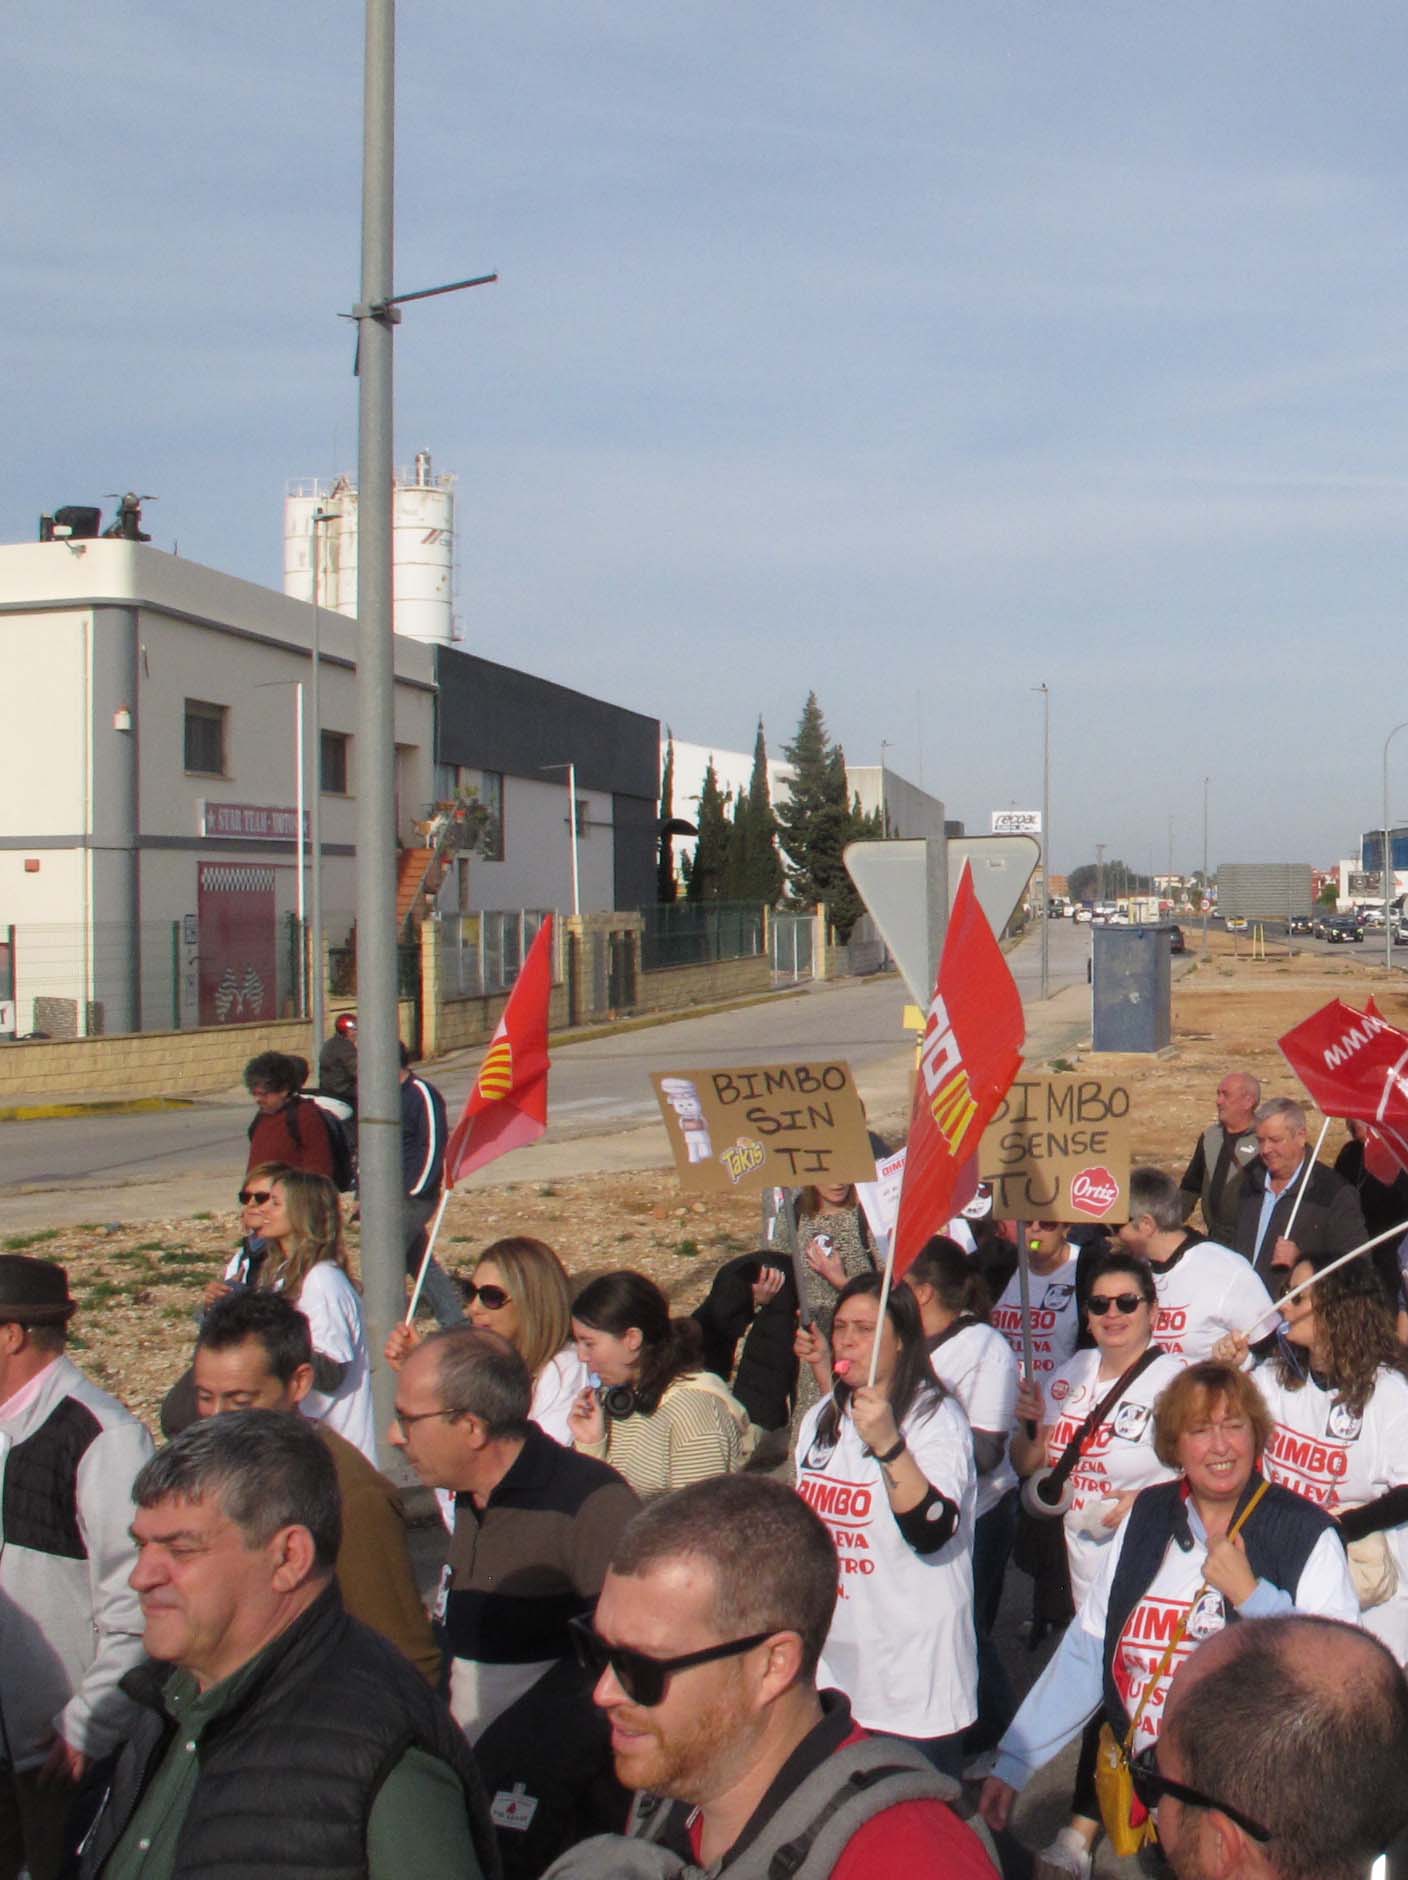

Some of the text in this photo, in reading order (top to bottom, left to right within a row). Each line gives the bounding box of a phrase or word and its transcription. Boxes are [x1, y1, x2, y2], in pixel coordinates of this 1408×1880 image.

[712, 1066, 846, 1105] BIMBO
[746, 1102, 835, 1135] SIN
[773, 1147, 832, 1175] TI
[1000, 1131, 1109, 1164] SENSE
[983, 1171, 1059, 1208] TU
[1073, 1176, 1116, 1201] Ortiz
[833, 1531, 869, 1549] EVA
